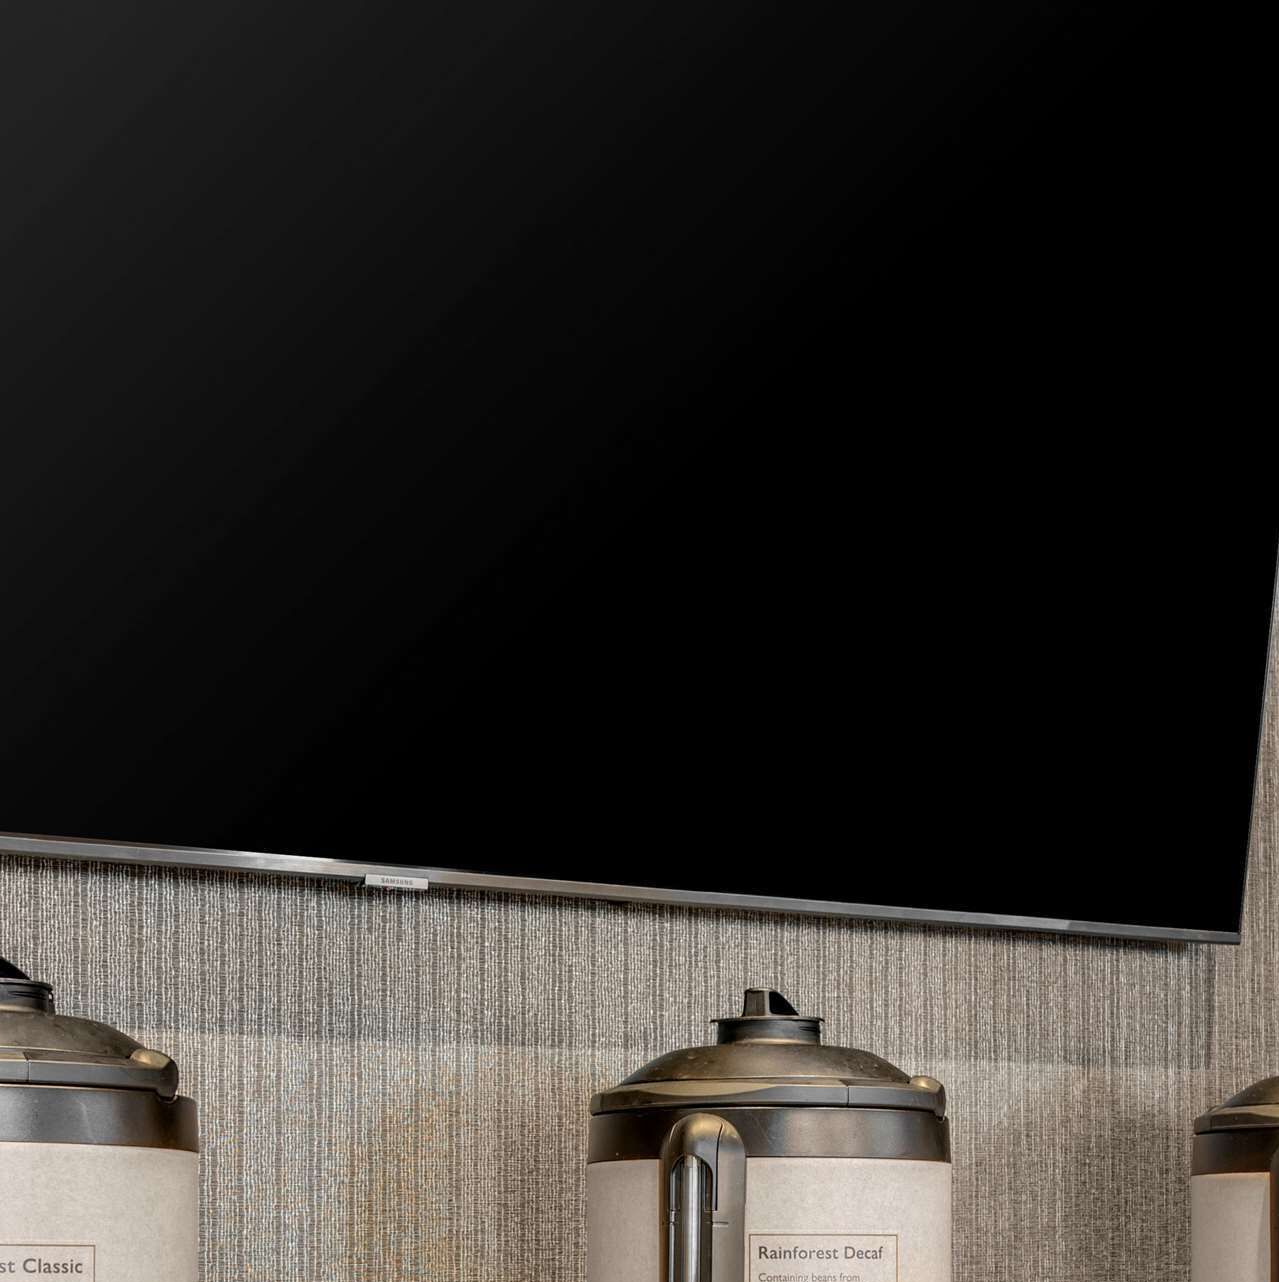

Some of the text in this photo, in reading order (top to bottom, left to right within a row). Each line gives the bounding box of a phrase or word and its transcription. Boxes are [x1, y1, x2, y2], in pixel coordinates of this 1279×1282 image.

[758, 1246, 883, 1259] Rainforest Decaf
[23, 1259, 83, 1273] Classic
[812, 1273, 836, 1282] beans
[840, 1273, 860, 1282] from
